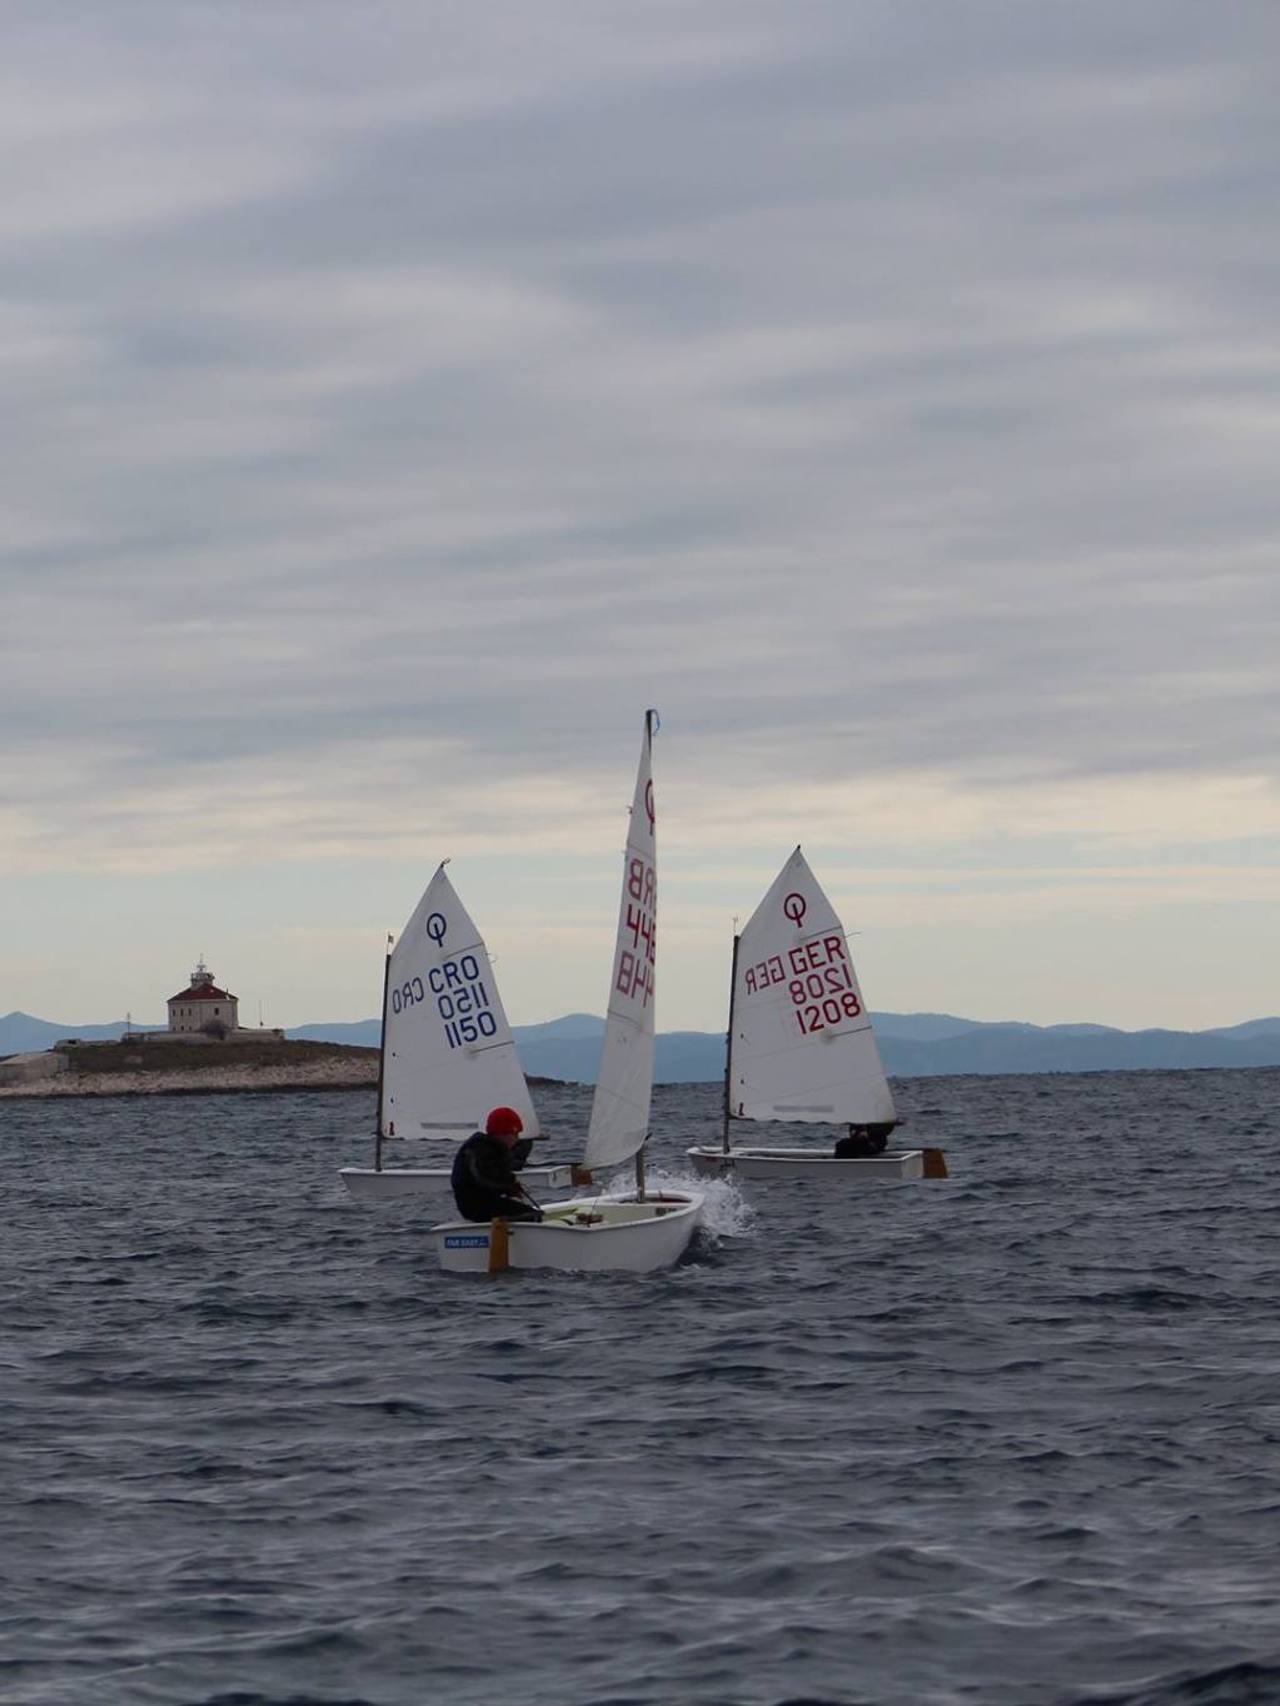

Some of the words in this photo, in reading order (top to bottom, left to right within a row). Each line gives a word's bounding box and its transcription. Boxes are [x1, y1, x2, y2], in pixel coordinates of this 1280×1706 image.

[428, 955, 480, 993] CRO
[788, 936, 845, 976] GER
[444, 1011, 497, 1049] 1150
[796, 992, 861, 1035] 1208
